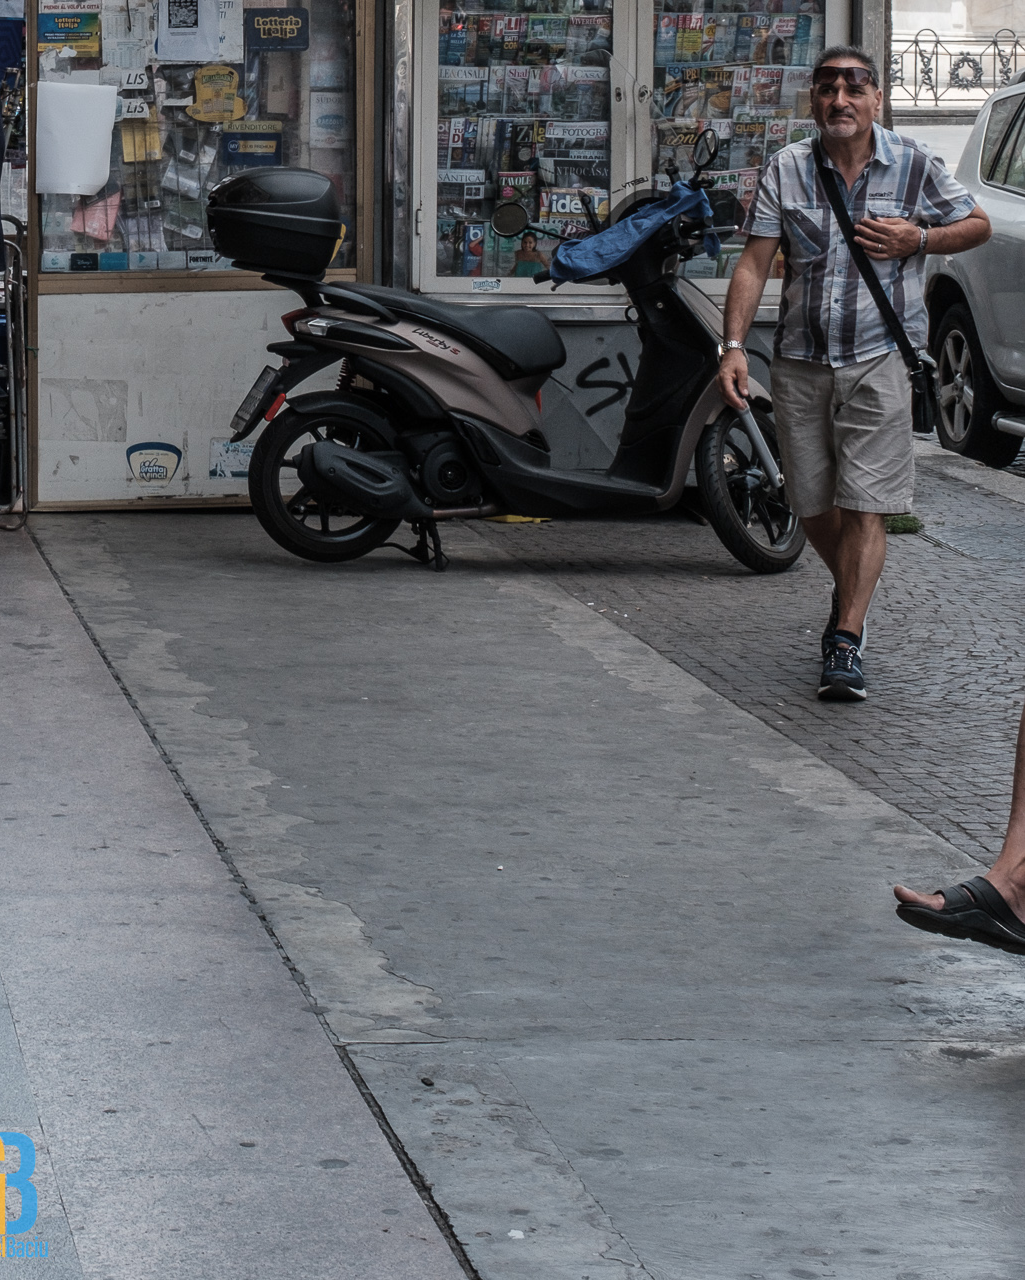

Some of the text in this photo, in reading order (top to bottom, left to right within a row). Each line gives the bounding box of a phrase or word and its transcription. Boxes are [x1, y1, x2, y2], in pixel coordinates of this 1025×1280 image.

[255, 16, 301, 27] Lotteria
[261, 26, 297, 38] Italia
[126, 73, 145, 85] LIS
[228, 123, 277, 131] RIVENDITORE
[735, 123, 765, 134] gusto
[552, 194, 599, 213] ide!
[189, 255, 213, 264] FORTNITE
